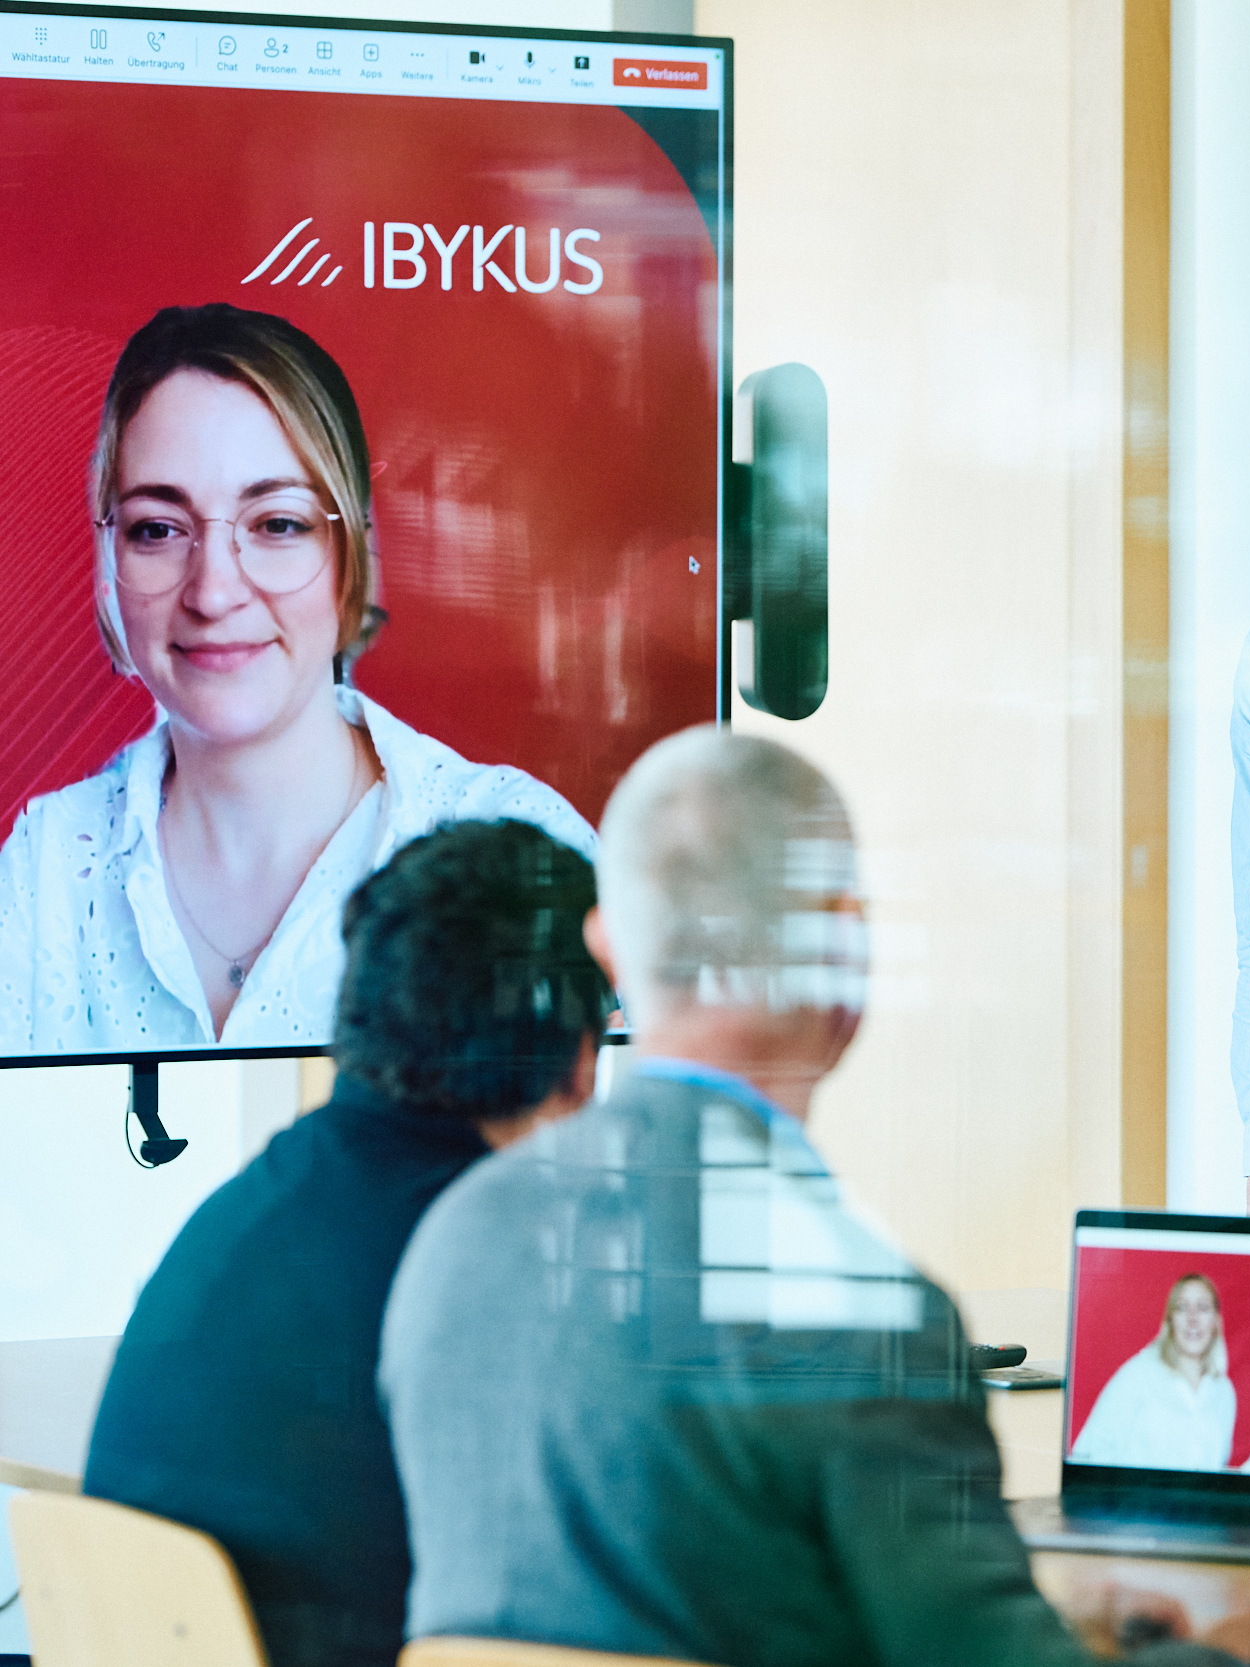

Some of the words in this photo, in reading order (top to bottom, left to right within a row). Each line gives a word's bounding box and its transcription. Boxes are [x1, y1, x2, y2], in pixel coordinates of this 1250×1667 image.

[282, 44, 289, 54] 2
[12, 52, 70, 64] Wähltastatur
[84, 56, 114, 66] Halten
[127, 57, 185, 71] Übertragung
[217, 61, 238, 72] Chat
[255, 63, 297, 75] Personen
[308, 66, 341, 77] Ansicht
[360, 69, 382, 80] Apps
[401, 71, 434, 81] Weitere
[645, 67, 699, 82] Verlassen
[461, 74, 493, 84] Kamera
[518, 77, 541, 86] Mikro
[570, 78, 594, 88] Teilen
[364, 221, 604, 295] IBYKUS
